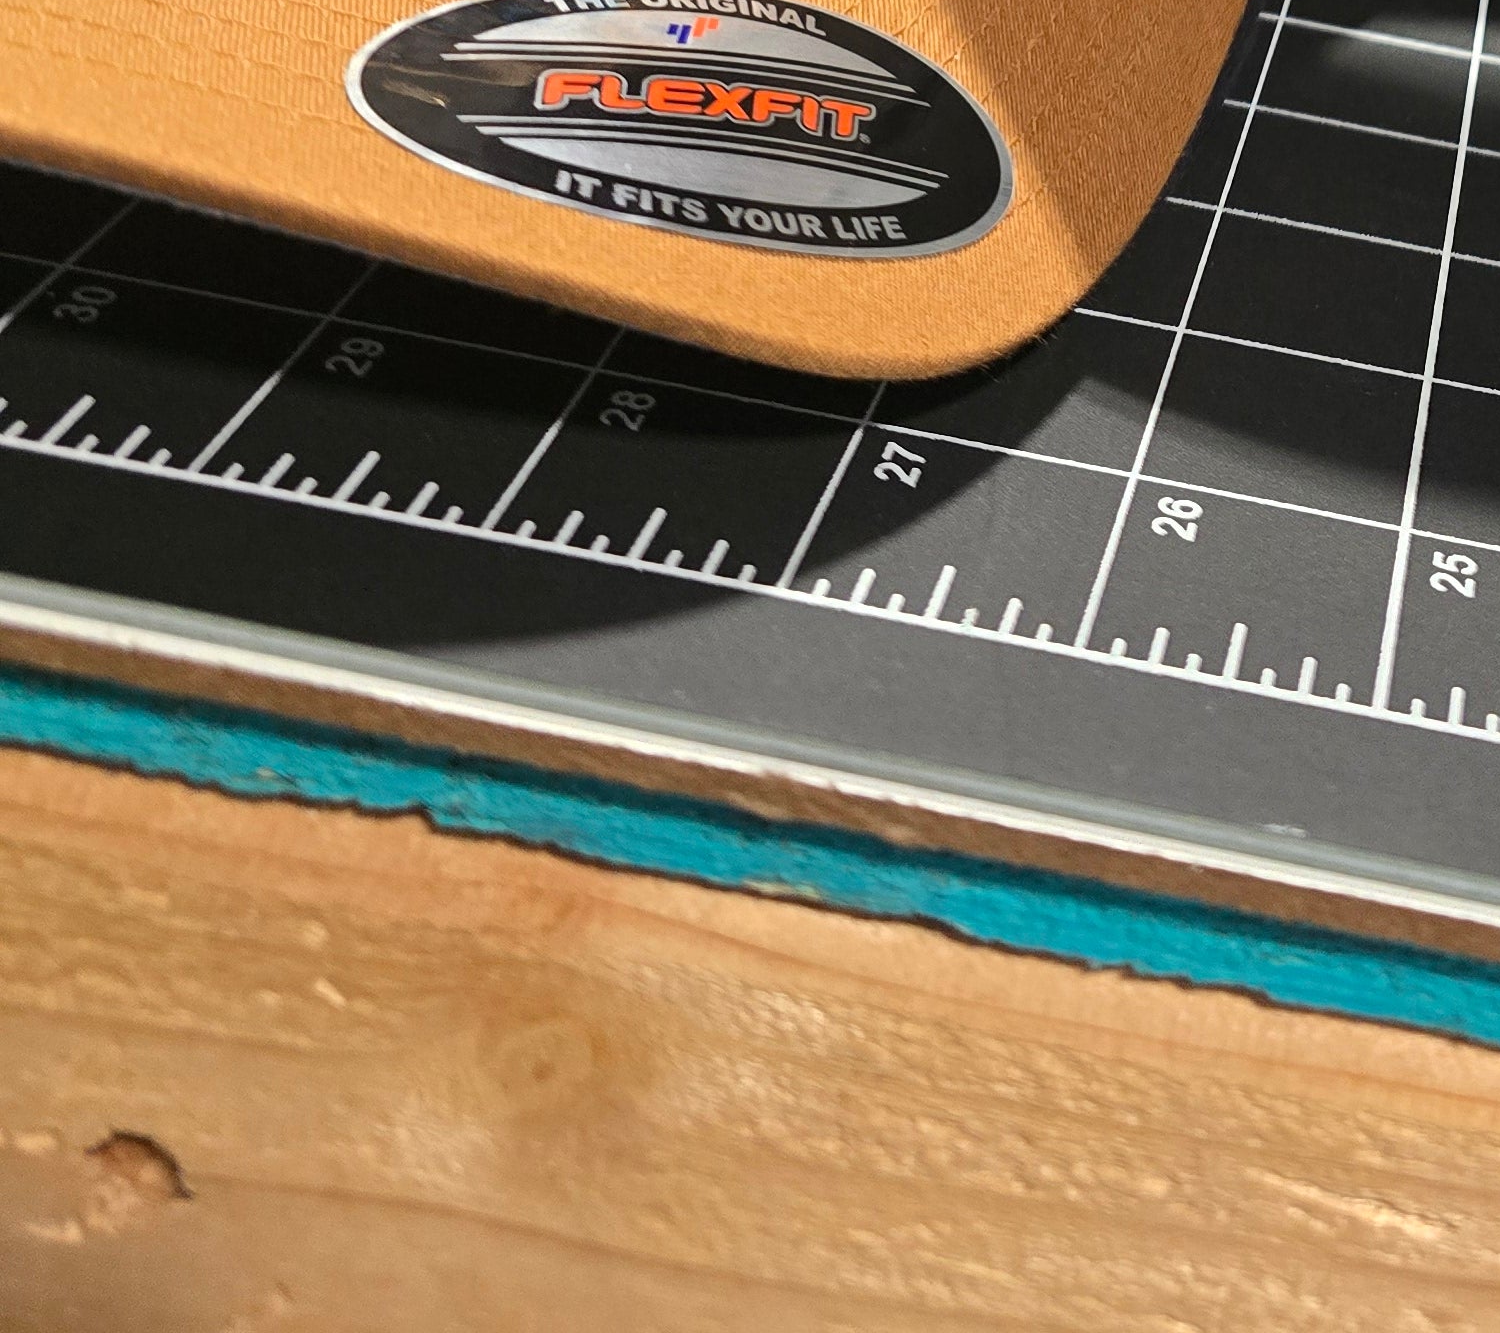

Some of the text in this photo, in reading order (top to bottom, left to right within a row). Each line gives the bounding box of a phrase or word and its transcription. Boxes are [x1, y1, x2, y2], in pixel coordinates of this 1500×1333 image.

[535, 68, 878, 141] FLEXFIT
[554, 169, 908, 242] IT FITS YOUR LIFE
[53, 284, 119, 324] 30
[324, 336, 387, 380] 29
[599, 389, 657, 433] 28
[872, 440, 928, 489] 27
[1151, 494, 1205, 543] 26
[1429, 551, 1479, 599] 25
